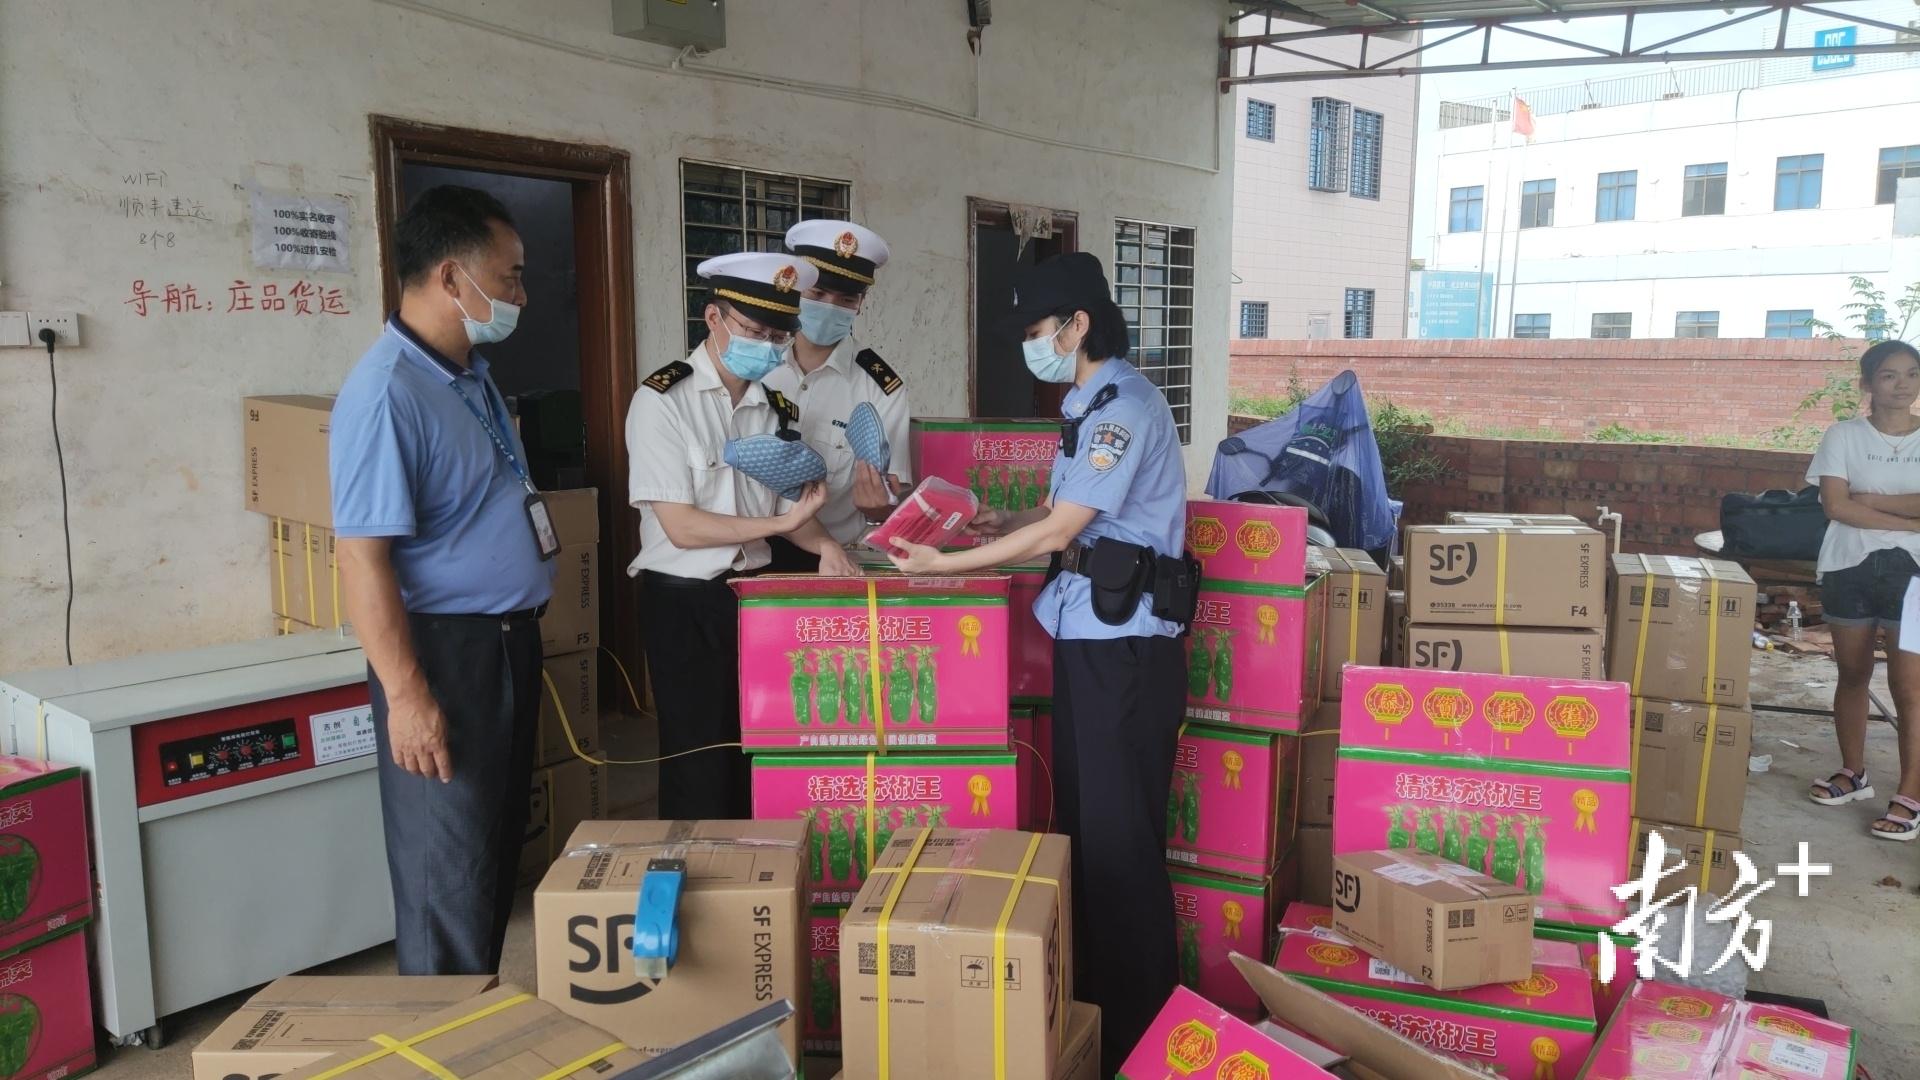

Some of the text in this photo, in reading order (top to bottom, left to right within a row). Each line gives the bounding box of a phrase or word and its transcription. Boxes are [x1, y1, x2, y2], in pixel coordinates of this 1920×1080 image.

[1580, 543, 1590, 589] SF EXPRESS
[1571, 605, 1588, 617] F4
[577, 633, 590, 645] F5
[1582, 644, 1591, 655] SF
[1396, 773, 1542, 812] 精选苏椒王
[753, 905, 773, 1001] SF EXPRESS
[1421, 965, 1433, 981] F2
